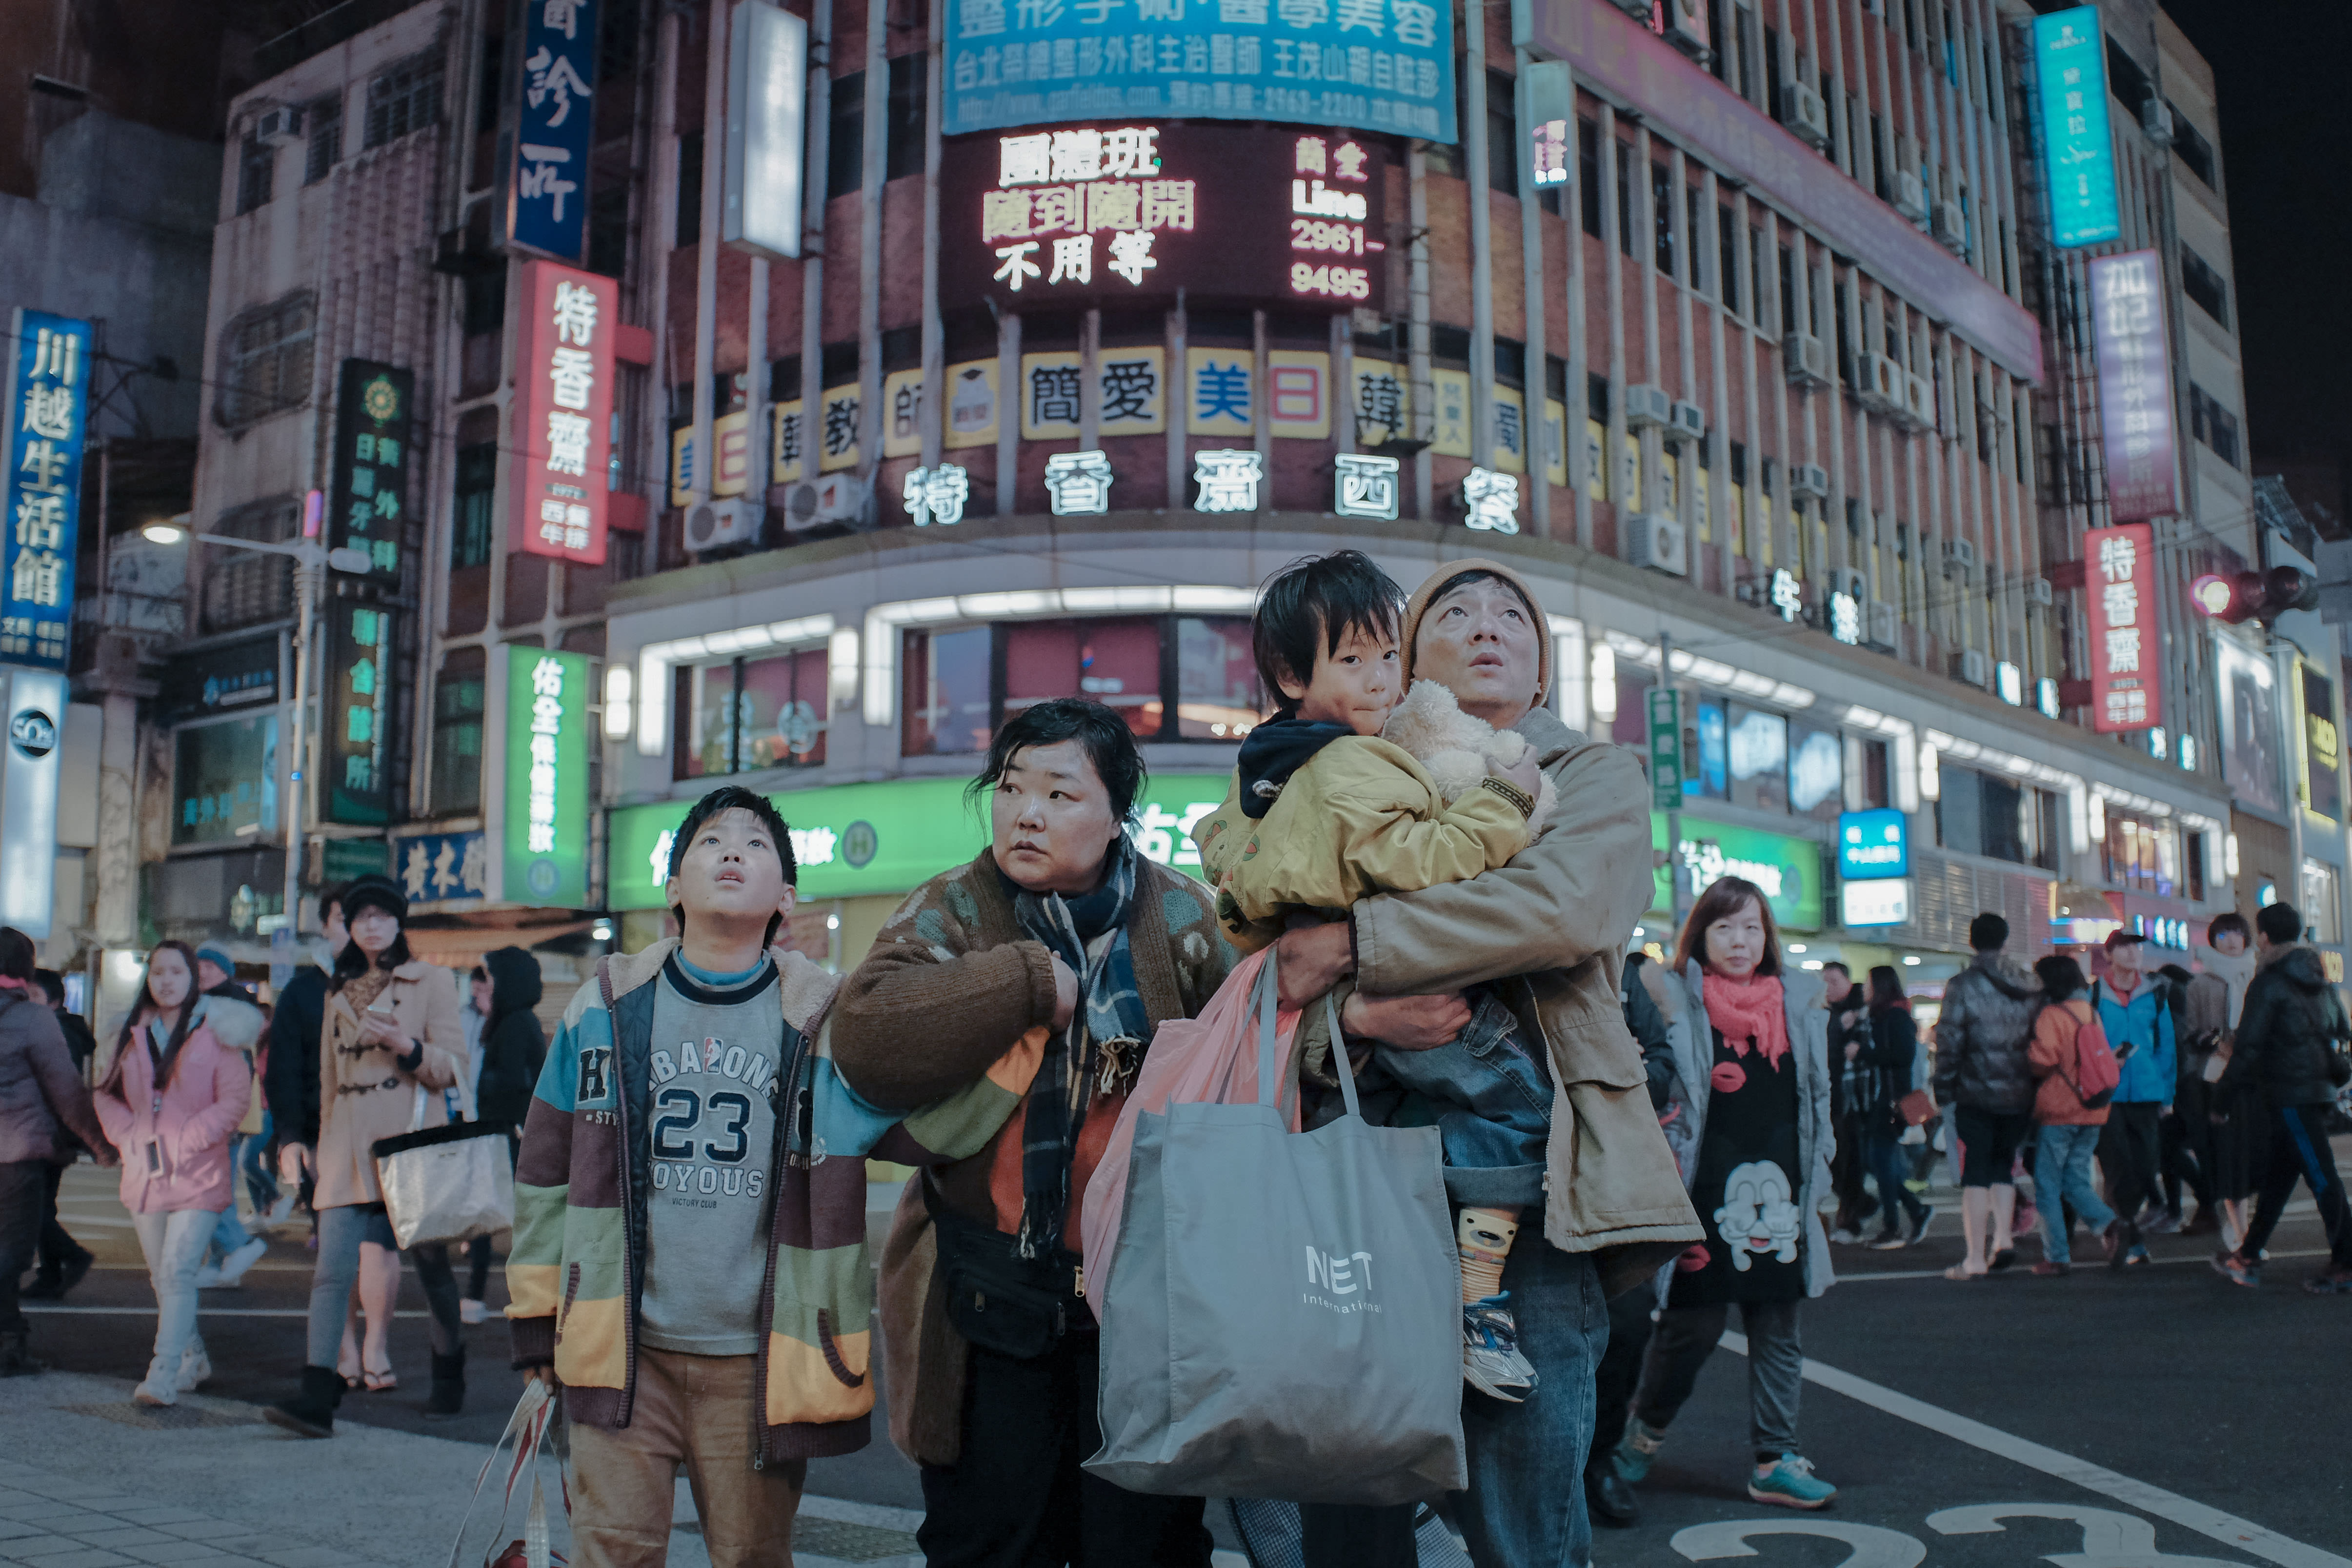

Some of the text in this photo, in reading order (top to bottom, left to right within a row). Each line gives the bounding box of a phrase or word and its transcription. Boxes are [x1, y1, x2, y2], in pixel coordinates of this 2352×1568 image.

[999, 127, 1159, 186] 團體班
[982, 179, 1196, 244] 隨到隨開
[1291, 179, 1367, 221] Line
[1290, 261, 1370, 300] 9495
[547, 280, 598, 477] 特香齋
[12, 327, 81, 608] 川越生活館
[2099, 536, 2141, 673] 特香齋
[578, 1048, 610, 1104] H
[651, 1086, 751, 1165] 23
[647, 1161, 764, 1198] OYOUS
[672, 1198, 717, 1209] VICTORY CLUB
[1306, 1245, 1372, 1294] NET
[1303, 1293, 1382, 1314] International
